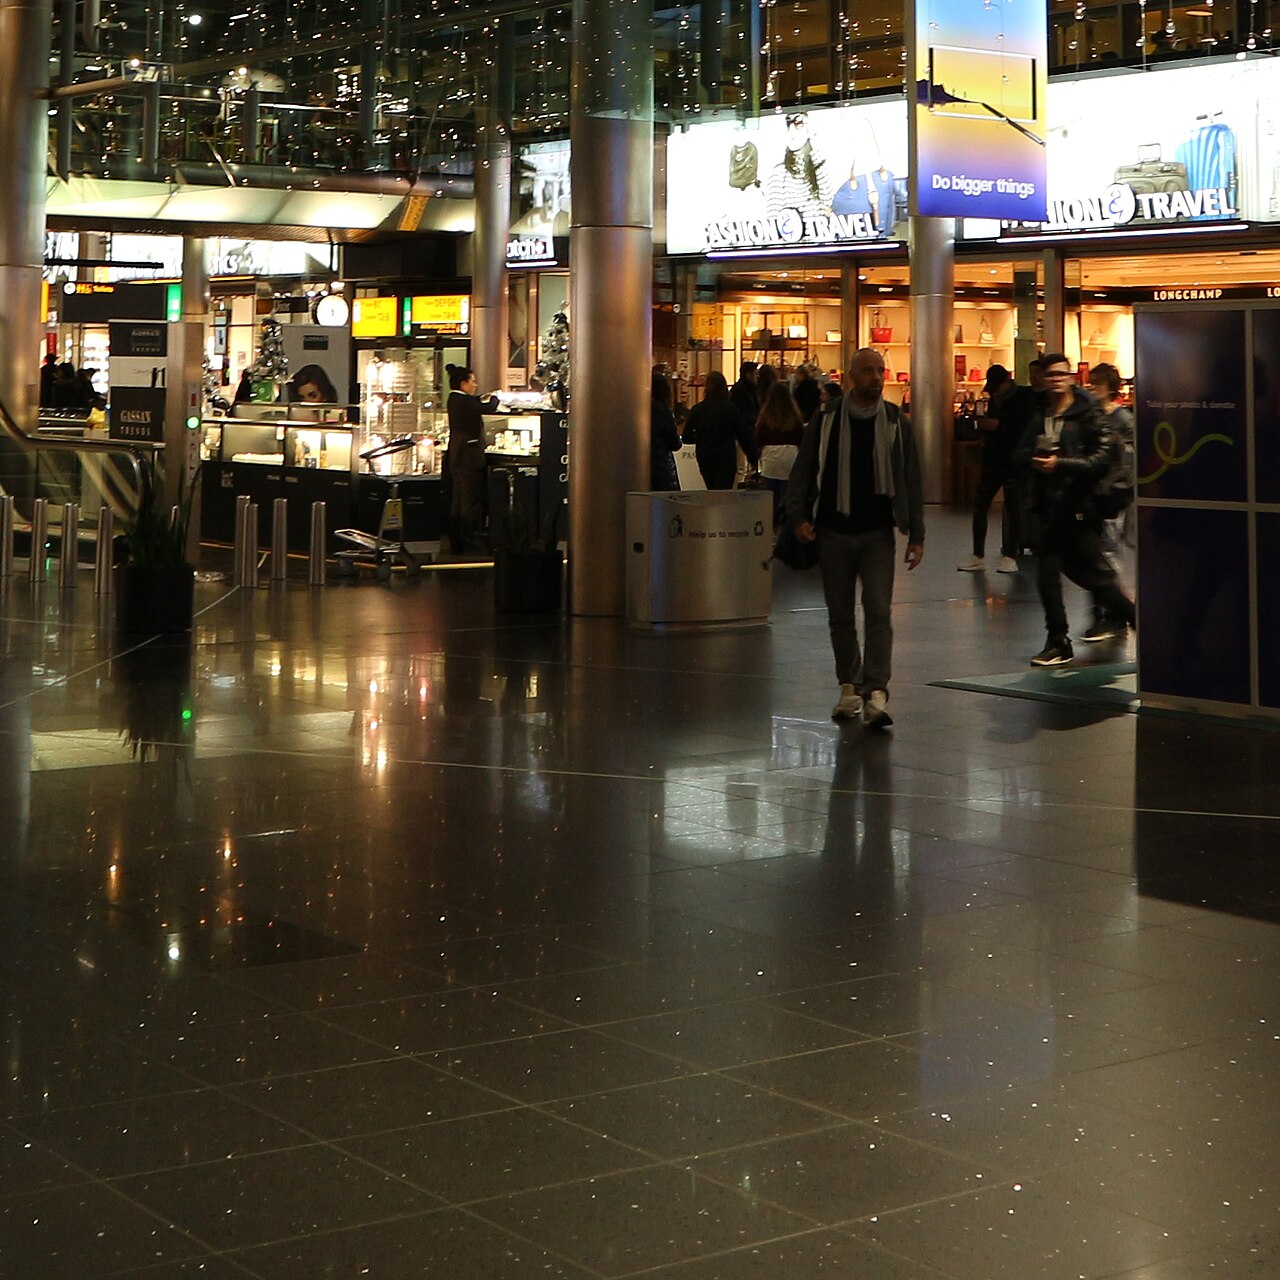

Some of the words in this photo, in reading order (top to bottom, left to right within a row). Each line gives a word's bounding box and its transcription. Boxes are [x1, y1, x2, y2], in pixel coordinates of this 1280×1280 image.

[932, 174, 951, 190] Do
[951, 174, 994, 196] bigger
[995, 178, 1035, 199] things
[1137, 187, 1237, 220] TRAVEL
[704, 219, 780, 246] FASHION
[803, 213, 880, 240] TRAVEL
[1154, 289, 1223, 301] LONGCHAMP
[1146, 400, 1162, 409] Take
[1163, 401, 1179, 410] your
[1180, 401, 1200, 410] photo
[688, 530, 707, 539] Help
[718, 530, 726, 538] to
[728, 530, 749, 539] recycle
